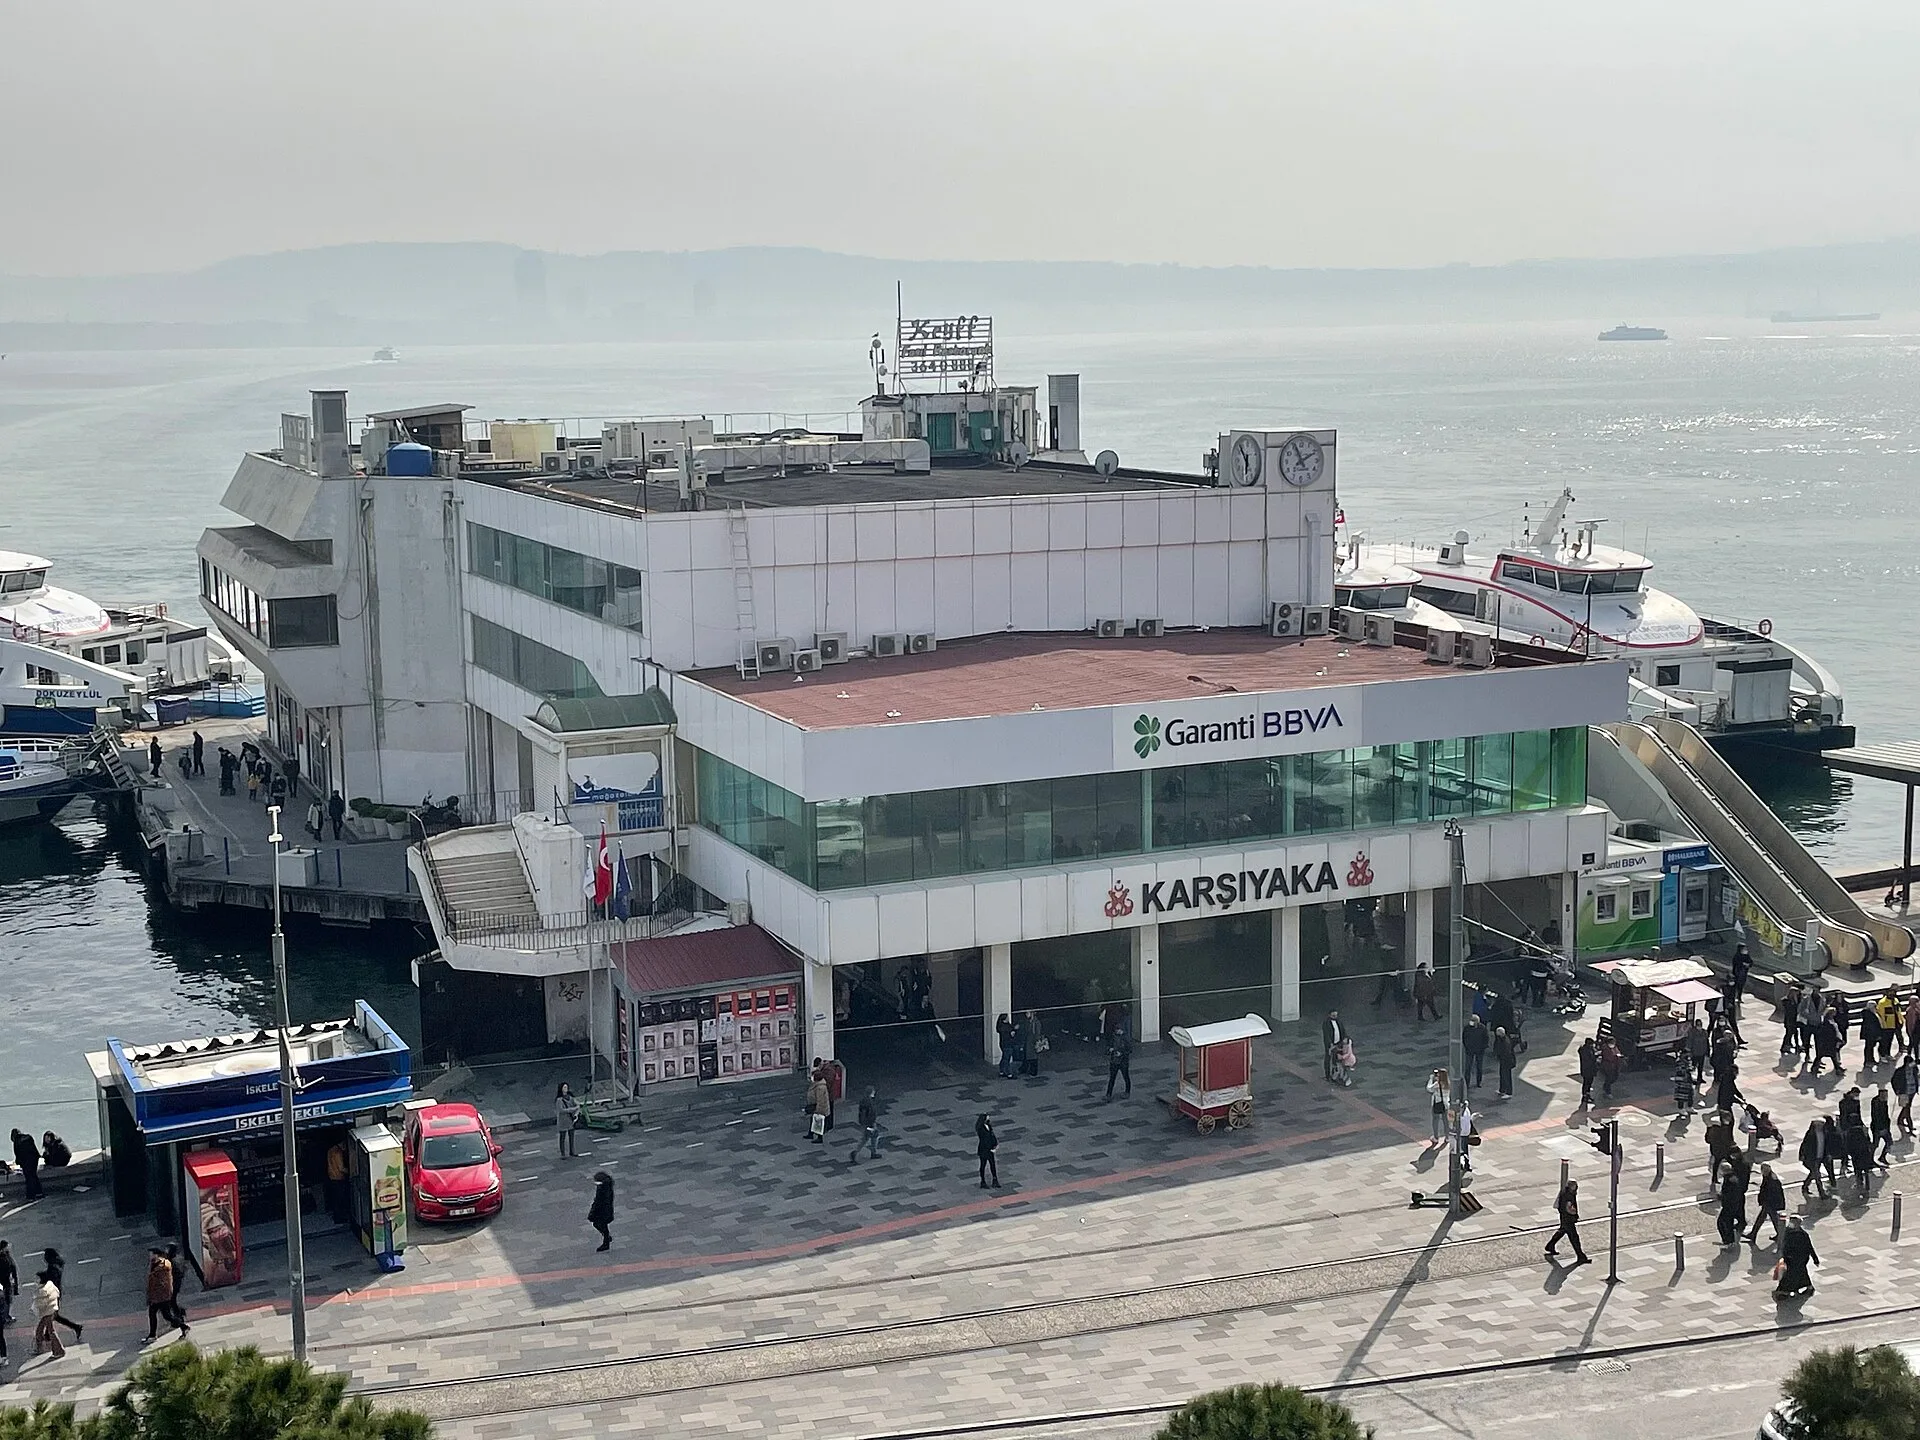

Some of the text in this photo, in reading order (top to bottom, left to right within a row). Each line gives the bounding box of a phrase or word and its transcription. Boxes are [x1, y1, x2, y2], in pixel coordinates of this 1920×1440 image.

[1165, 703, 1344, 747] Garanti BBVA
[1621, 856, 1647, 869] BBVA
[1141, 861, 1339, 915] KARŞIYAKA
[245, 1082, 279, 1096] İSKELE
[235, 1105, 330, 1130] İSKELE EKEL
